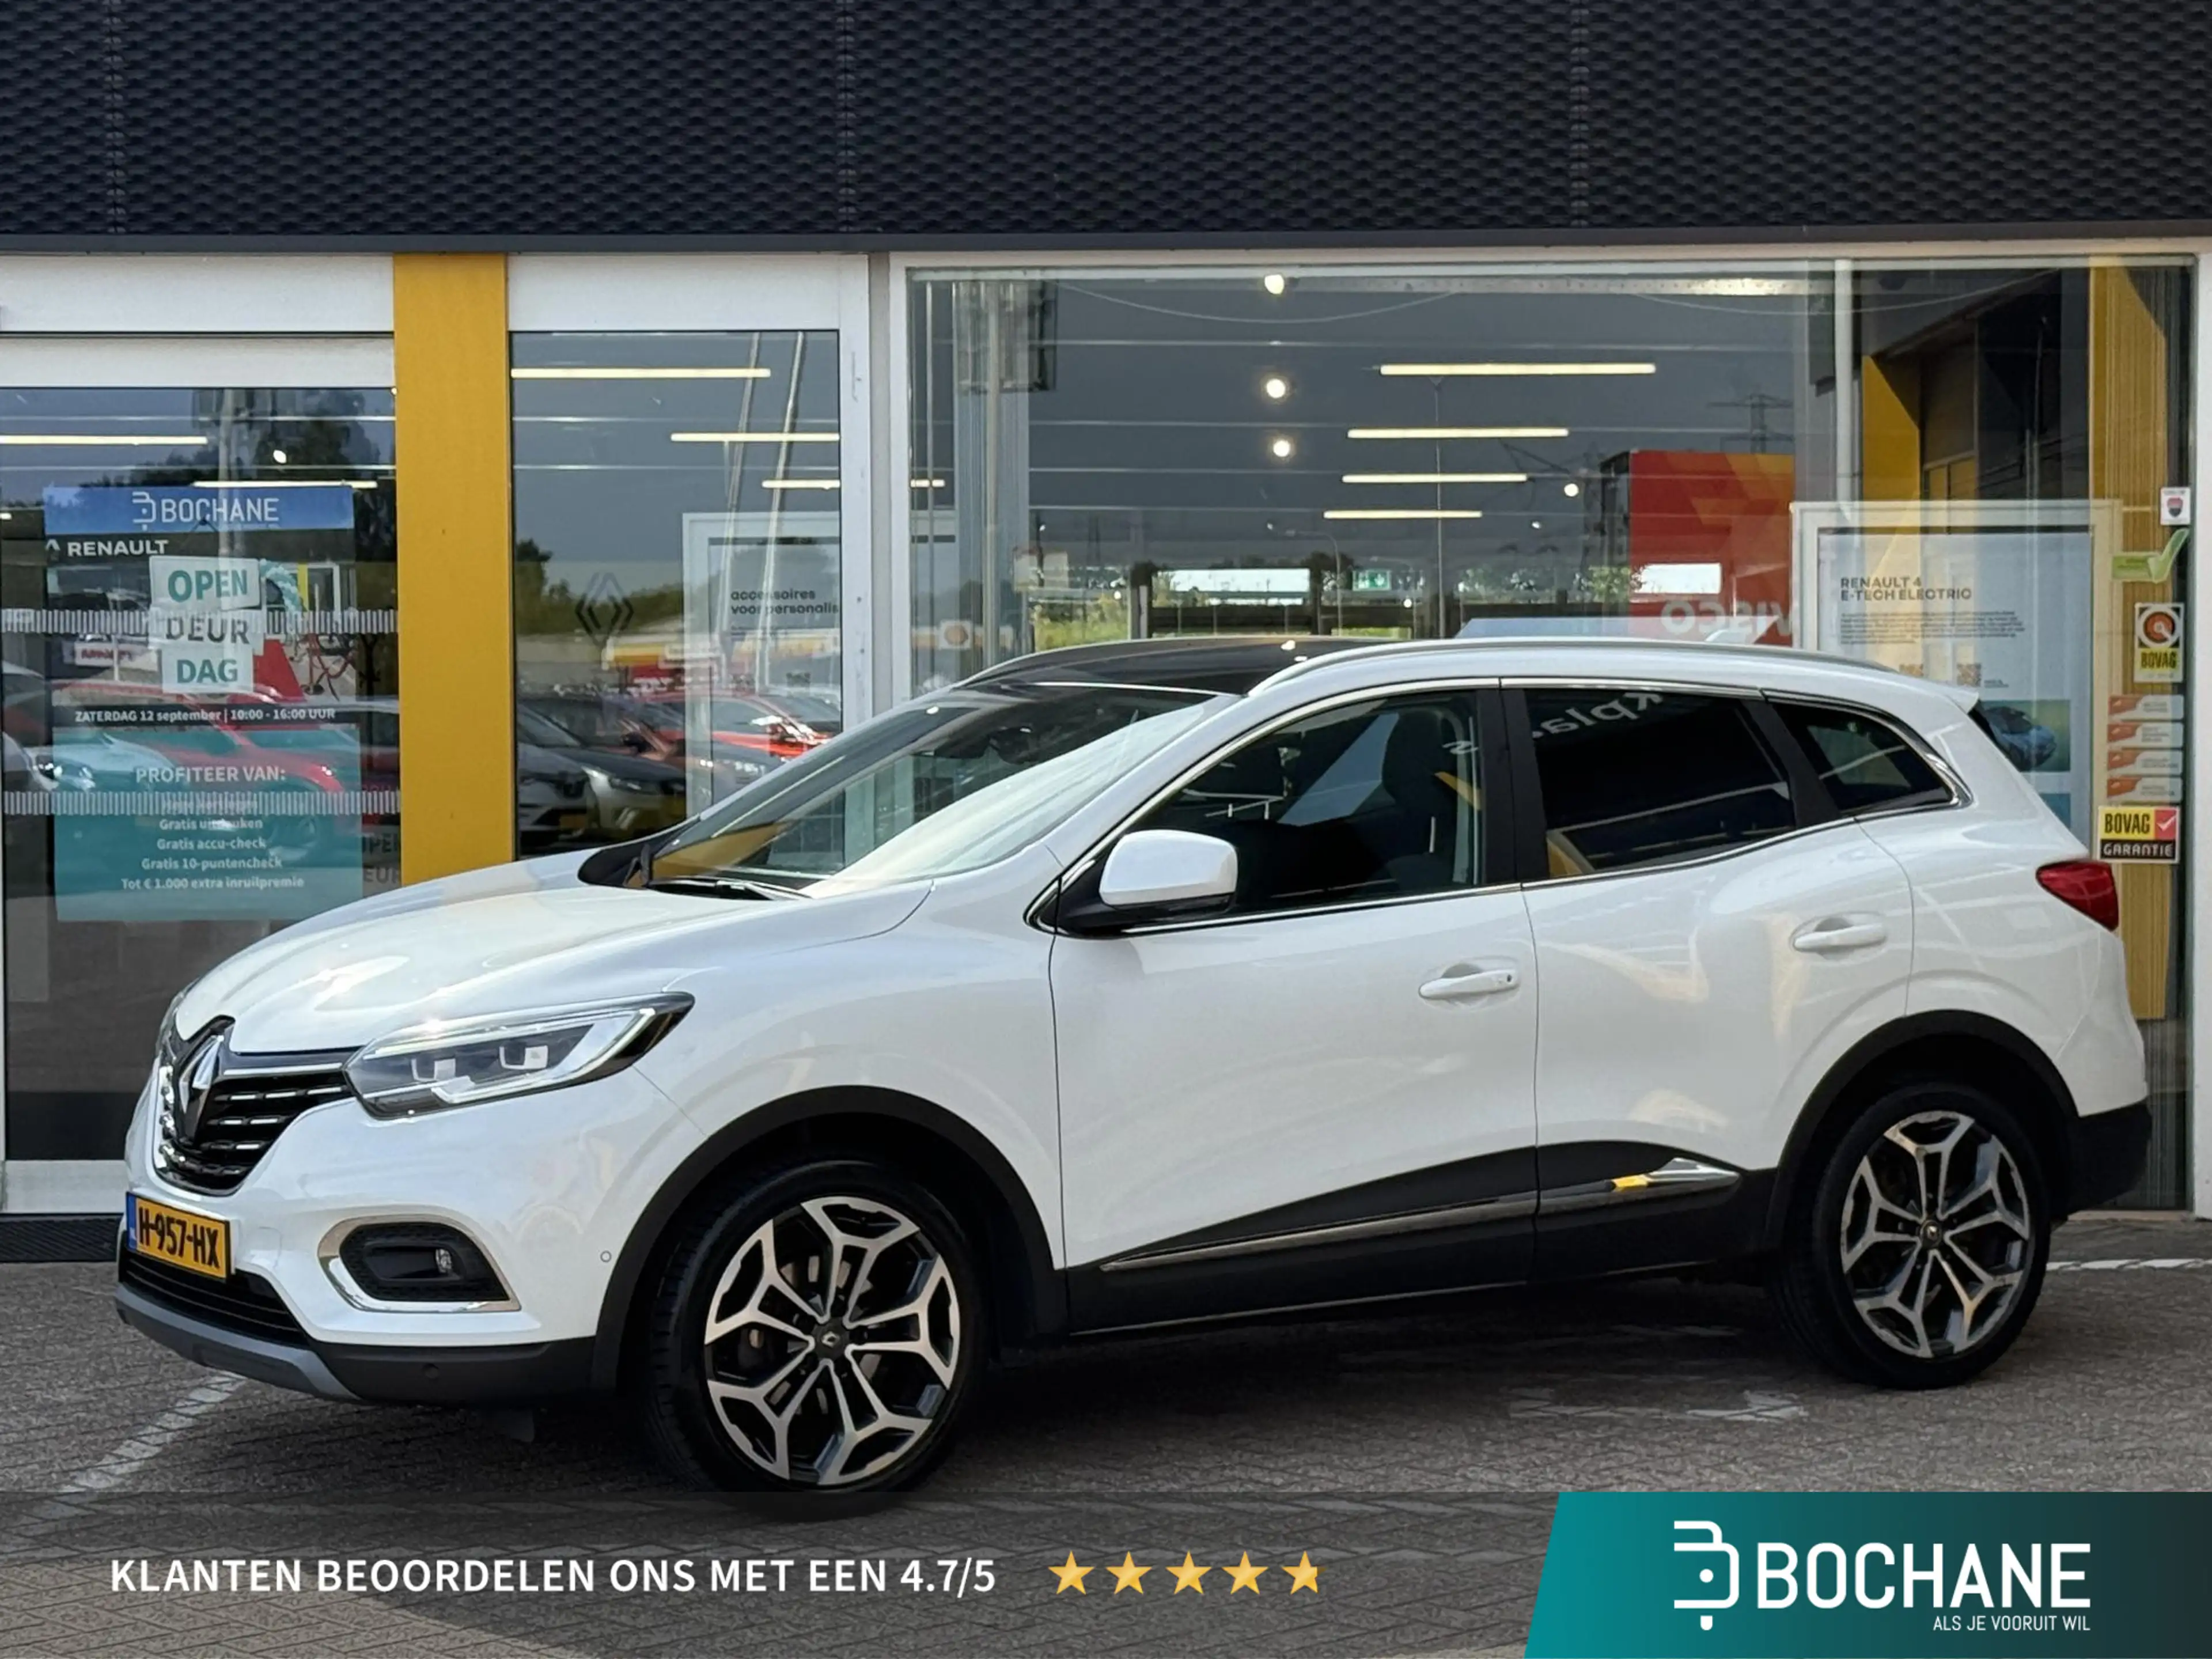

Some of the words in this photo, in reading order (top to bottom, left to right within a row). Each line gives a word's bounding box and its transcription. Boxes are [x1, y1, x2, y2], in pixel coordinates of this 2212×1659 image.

[161, 498, 279, 522] BOCHANE
[67, 540, 169, 556] RENAULT
[168, 570, 248, 603] OPEN
[1840, 577, 1910, 588] RENAULT
[1840, 589, 1896, 601] E-TECH
[1899, 588, 1972, 600] ELECTRIC
[166, 619, 249, 644] DEUR
[2141, 651, 2177, 669] BOVAG
[177, 659, 238, 683] DAG
[75, 710, 137, 722] ZATERDAG
[140, 710, 154, 721] 12
[156, 710, 222, 724] september
[230, 709, 263, 720] 10:00
[273, 709, 306, 720] 16:00
[308, 708, 335, 719] UUR
[136, 767, 239, 782] PROFITEER
[243, 766, 286, 781] VAN:
[159, 819, 196, 830] Gratis
[2104, 813, 2150, 834] BOVAG
[157, 838, 194, 850] Gratis
[197, 836, 267, 850] accu-check
[141, 858, 179, 870] Gratis
[182, 857, 283, 872] 10-puntencheck
[121, 878, 141, 889] Tot
[154, 878, 188, 889] 1.000
[191, 878, 224, 889] extra
[226, 876, 304, 890] inruilpremie
[138, 1206, 221, 1269] H-957-HX
